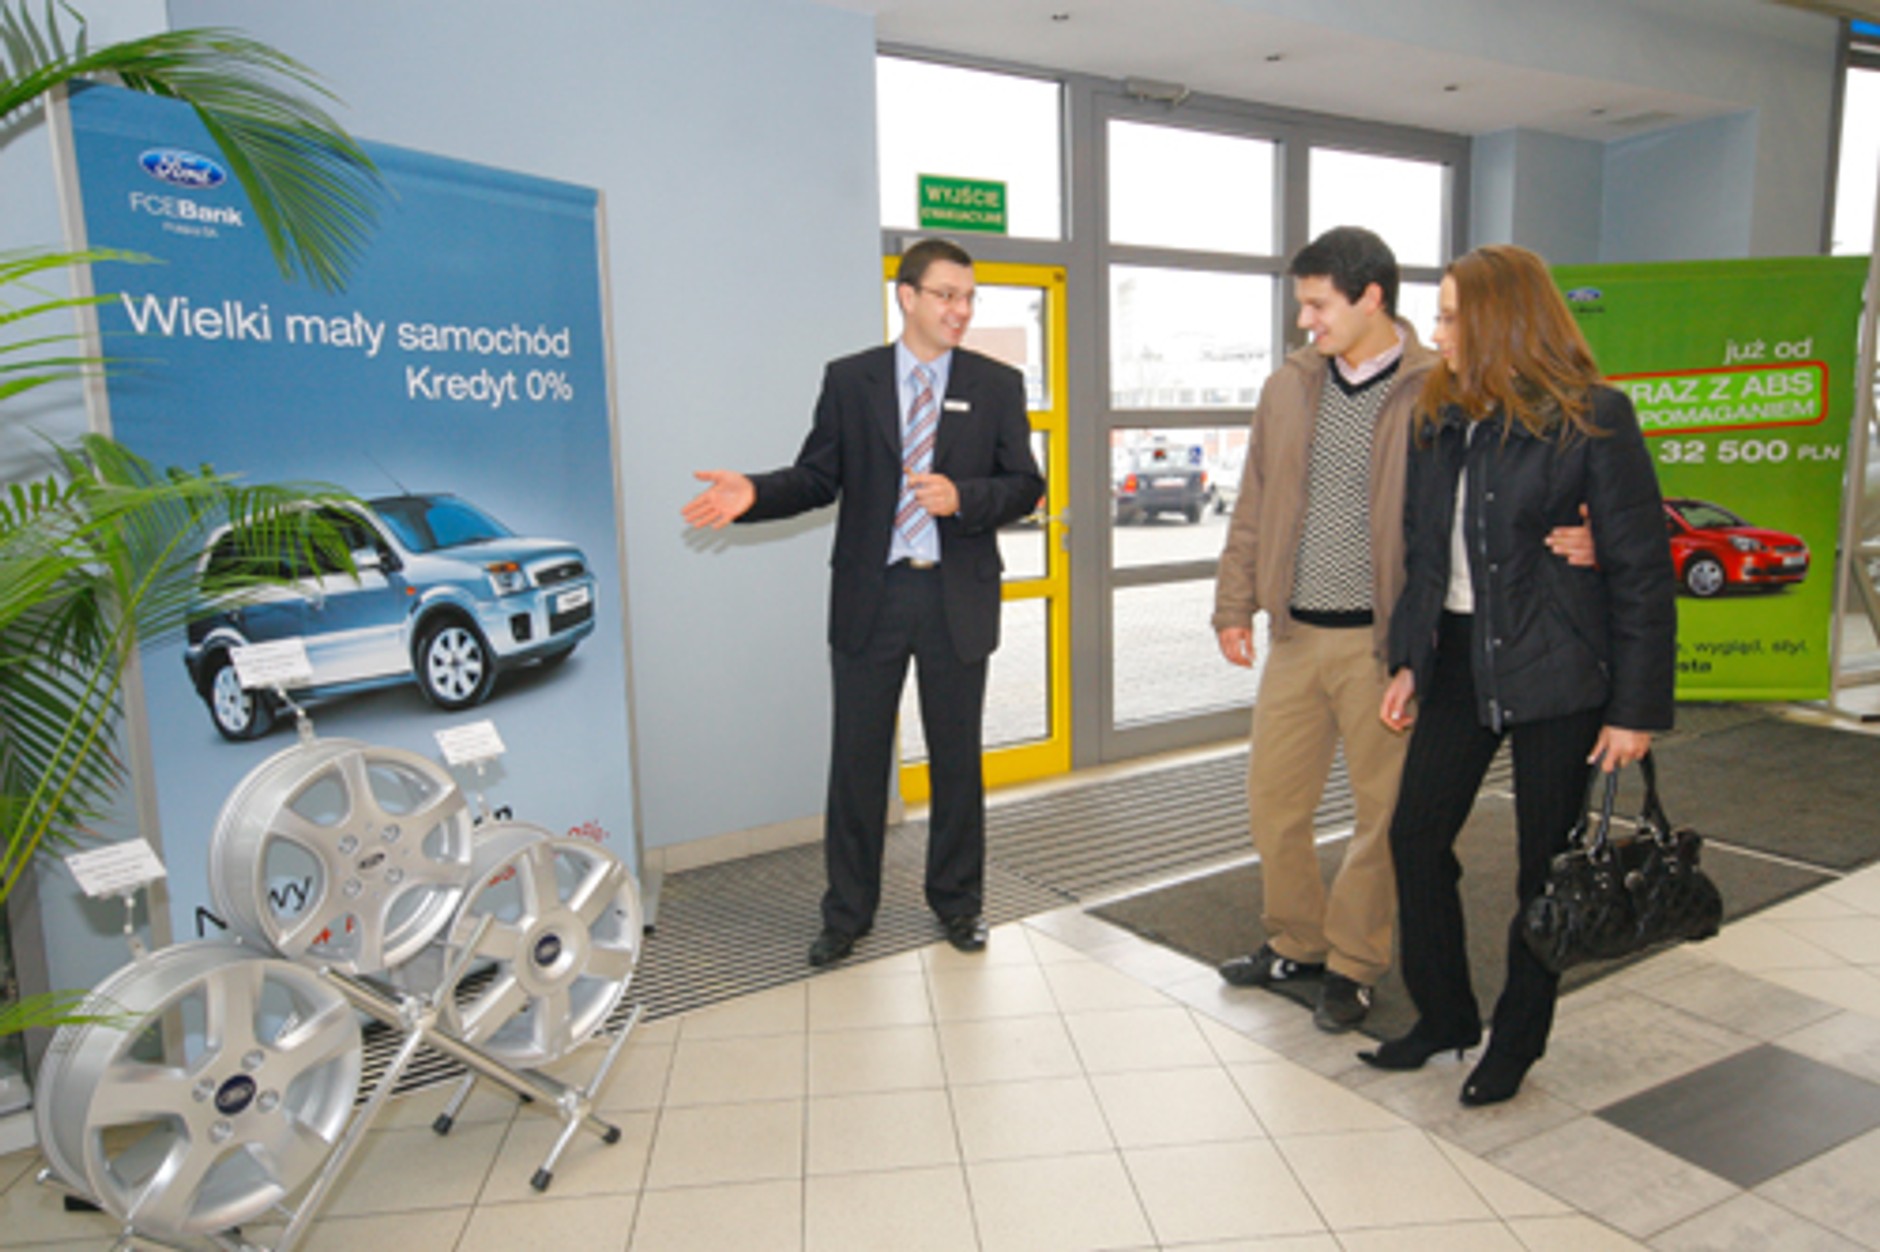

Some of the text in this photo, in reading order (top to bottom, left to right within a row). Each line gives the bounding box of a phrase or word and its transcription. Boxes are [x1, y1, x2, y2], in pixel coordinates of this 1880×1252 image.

[925, 185, 1000, 207] WYJŚCIE
[120, 290, 571, 357] Wielki mały samochód
[1723, 338, 1812, 365] już od
[405, 365, 574, 408] Kredyt 0%
[1616, 371, 1814, 404] RAZ Z ABS
[1638, 400, 1814, 426] POMAGANIEM
[1659, 438, 1841, 463] 32 500 PLN
[1676, 658, 1712, 674] sta
